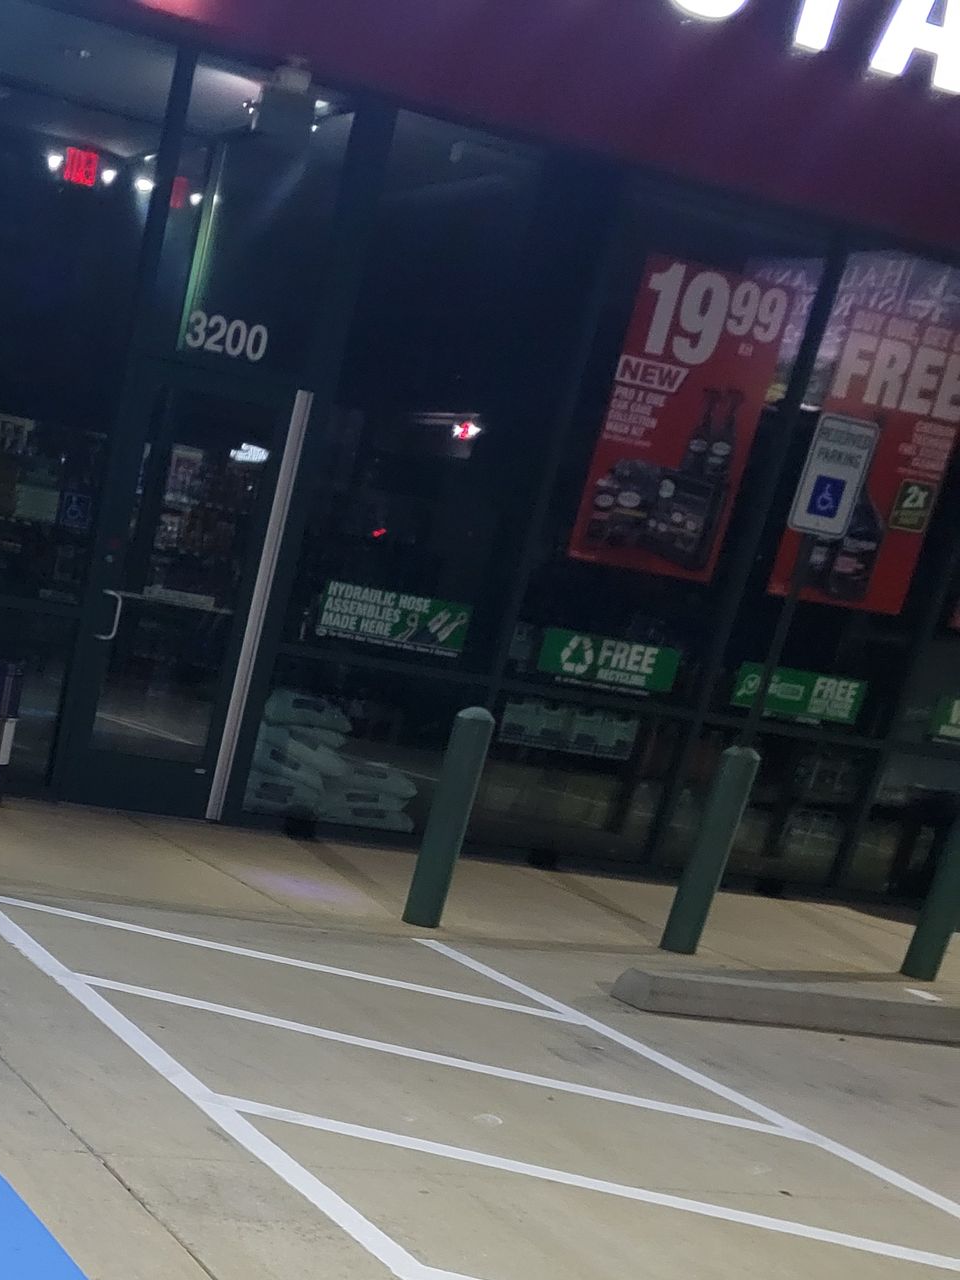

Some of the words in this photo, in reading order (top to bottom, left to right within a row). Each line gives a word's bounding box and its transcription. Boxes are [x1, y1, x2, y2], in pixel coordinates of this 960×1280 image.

[185, 310, 268, 362] 3200
[620, 358, 681, 390] NEW
[816, 447, 863, 469] PARKING
[324, 597, 401, 623] ASSEMBLIES
[328, 580, 397, 607] HYDRAULIC
[398, 593, 432, 613] HOSE
[321, 611, 358, 631] MADE
[359, 618, 392, 636] HERE
[597, 639, 659, 674] FREE
[810, 675, 860, 703] FREE
